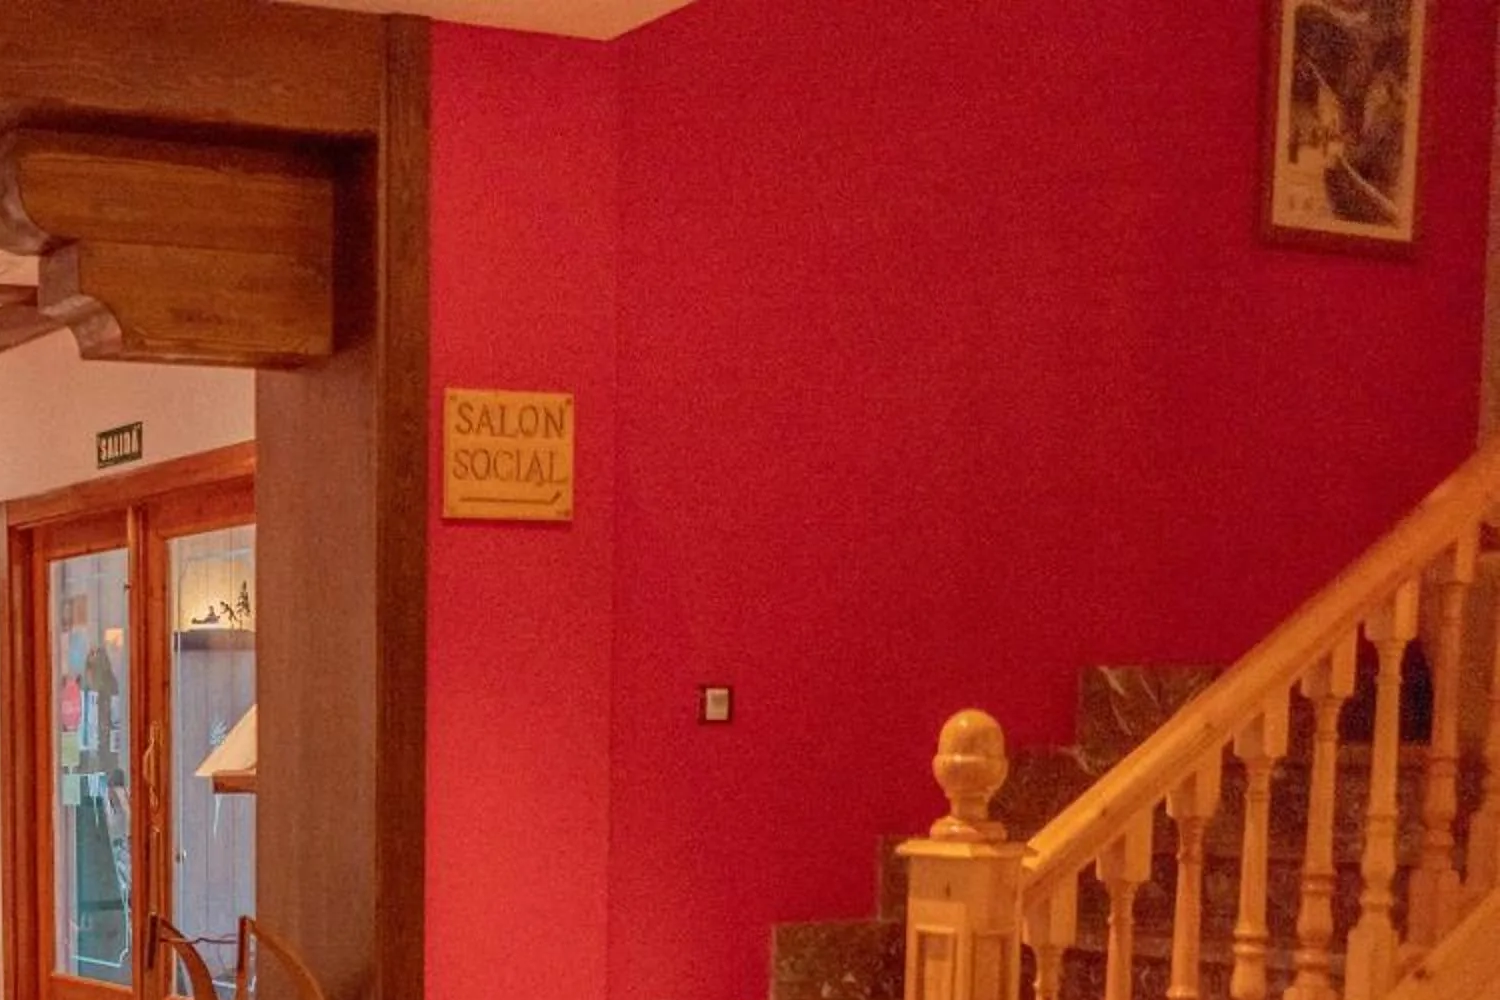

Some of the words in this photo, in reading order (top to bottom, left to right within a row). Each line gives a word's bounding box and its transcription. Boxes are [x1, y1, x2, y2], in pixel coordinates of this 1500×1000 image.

[455, 402, 565, 438] SALON
[100, 429, 139, 460] SALIDA
[452, 449, 568, 484] SOCIAL
